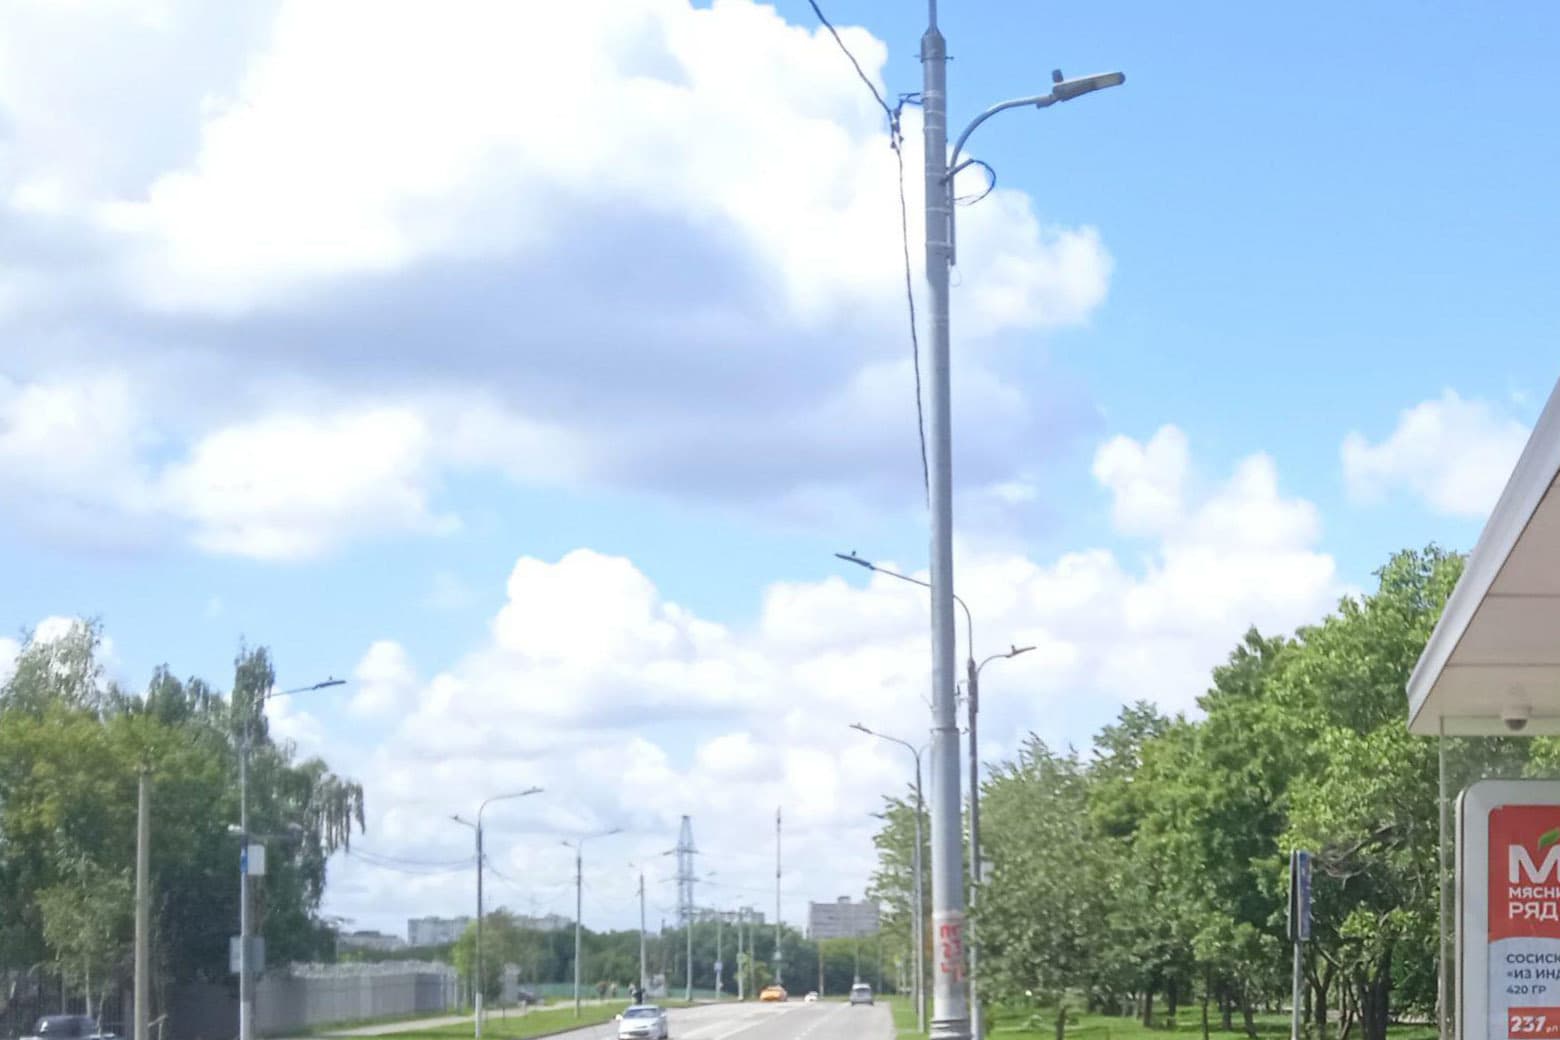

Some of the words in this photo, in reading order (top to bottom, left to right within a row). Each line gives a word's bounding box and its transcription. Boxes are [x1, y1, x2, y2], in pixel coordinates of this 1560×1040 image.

[1508, 902, 1559, 922] РЯД
[1506, 969, 1532, 979] «ИЗ
[1506, 985, 1529, 995] 420
[1532, 985, 1547, 994] ГР
